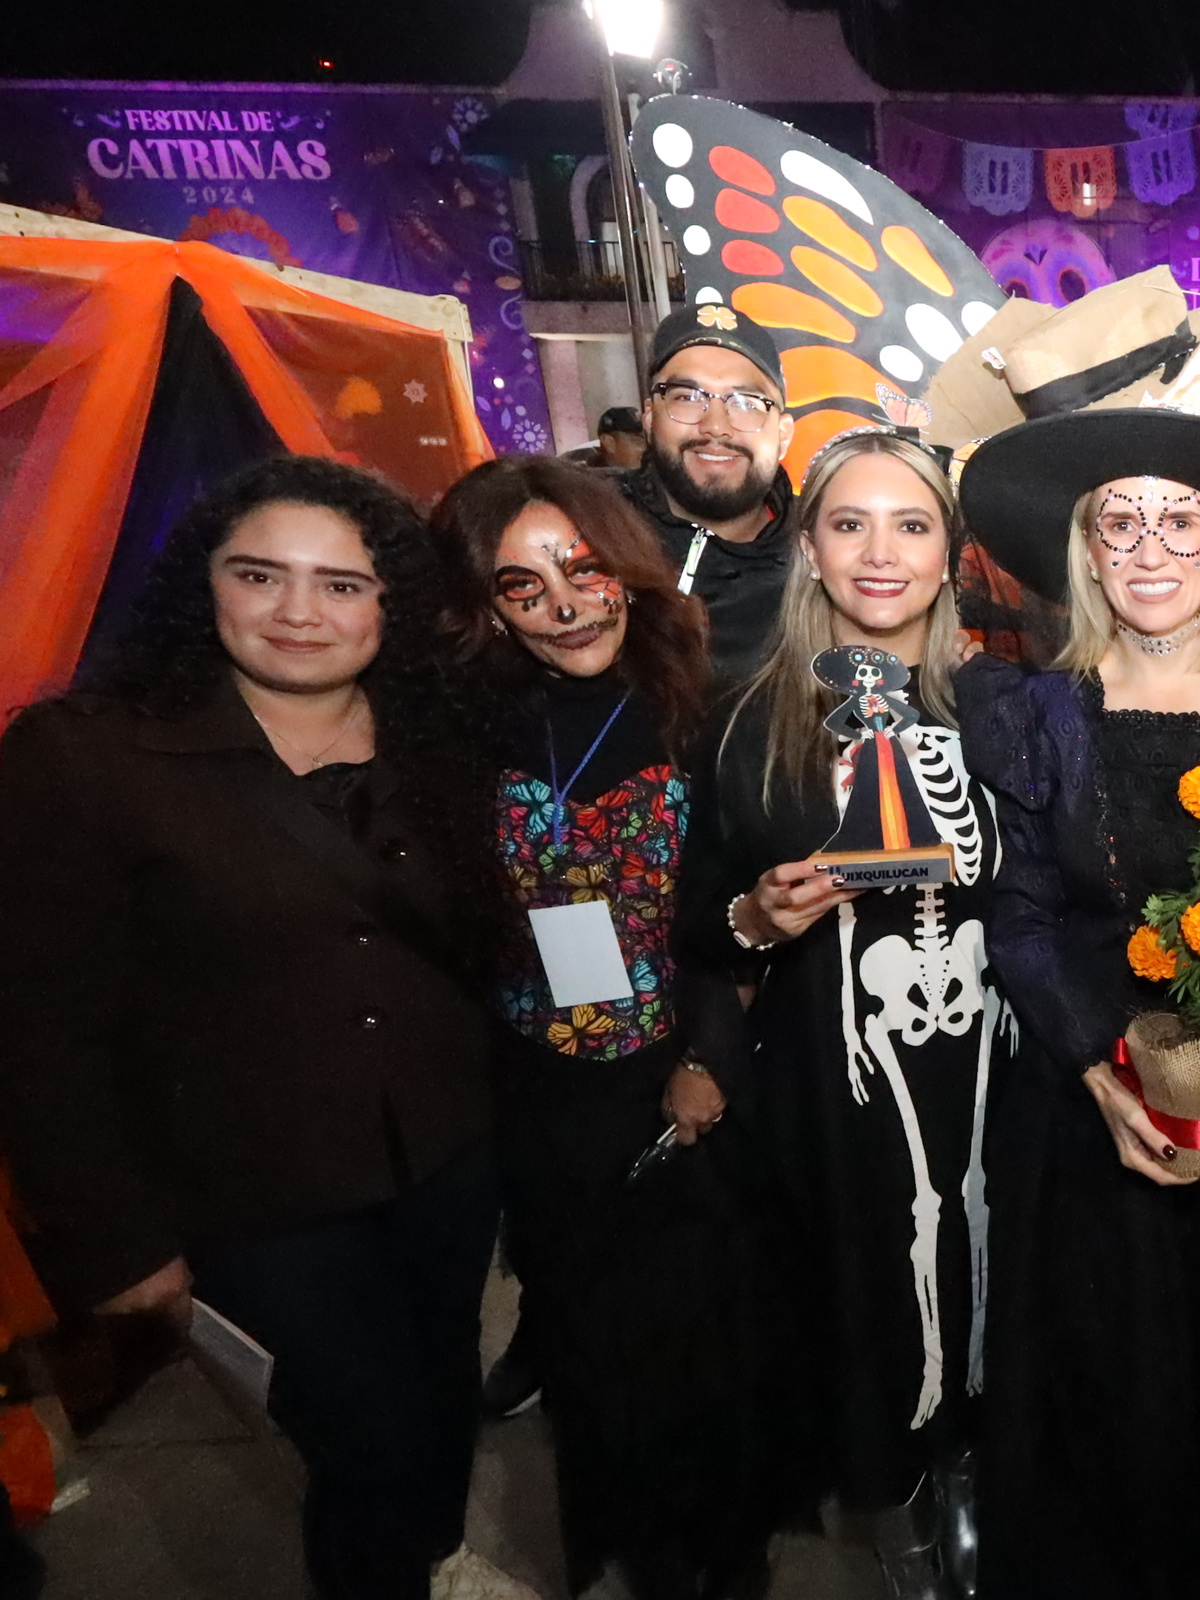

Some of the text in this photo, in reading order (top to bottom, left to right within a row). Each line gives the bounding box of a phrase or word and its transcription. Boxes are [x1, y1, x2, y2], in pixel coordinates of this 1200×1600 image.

[124, 109, 275, 132] FESTIVAL DE
[87, 138, 332, 180] CATRINAS
[182, 186, 255, 204] 2024
